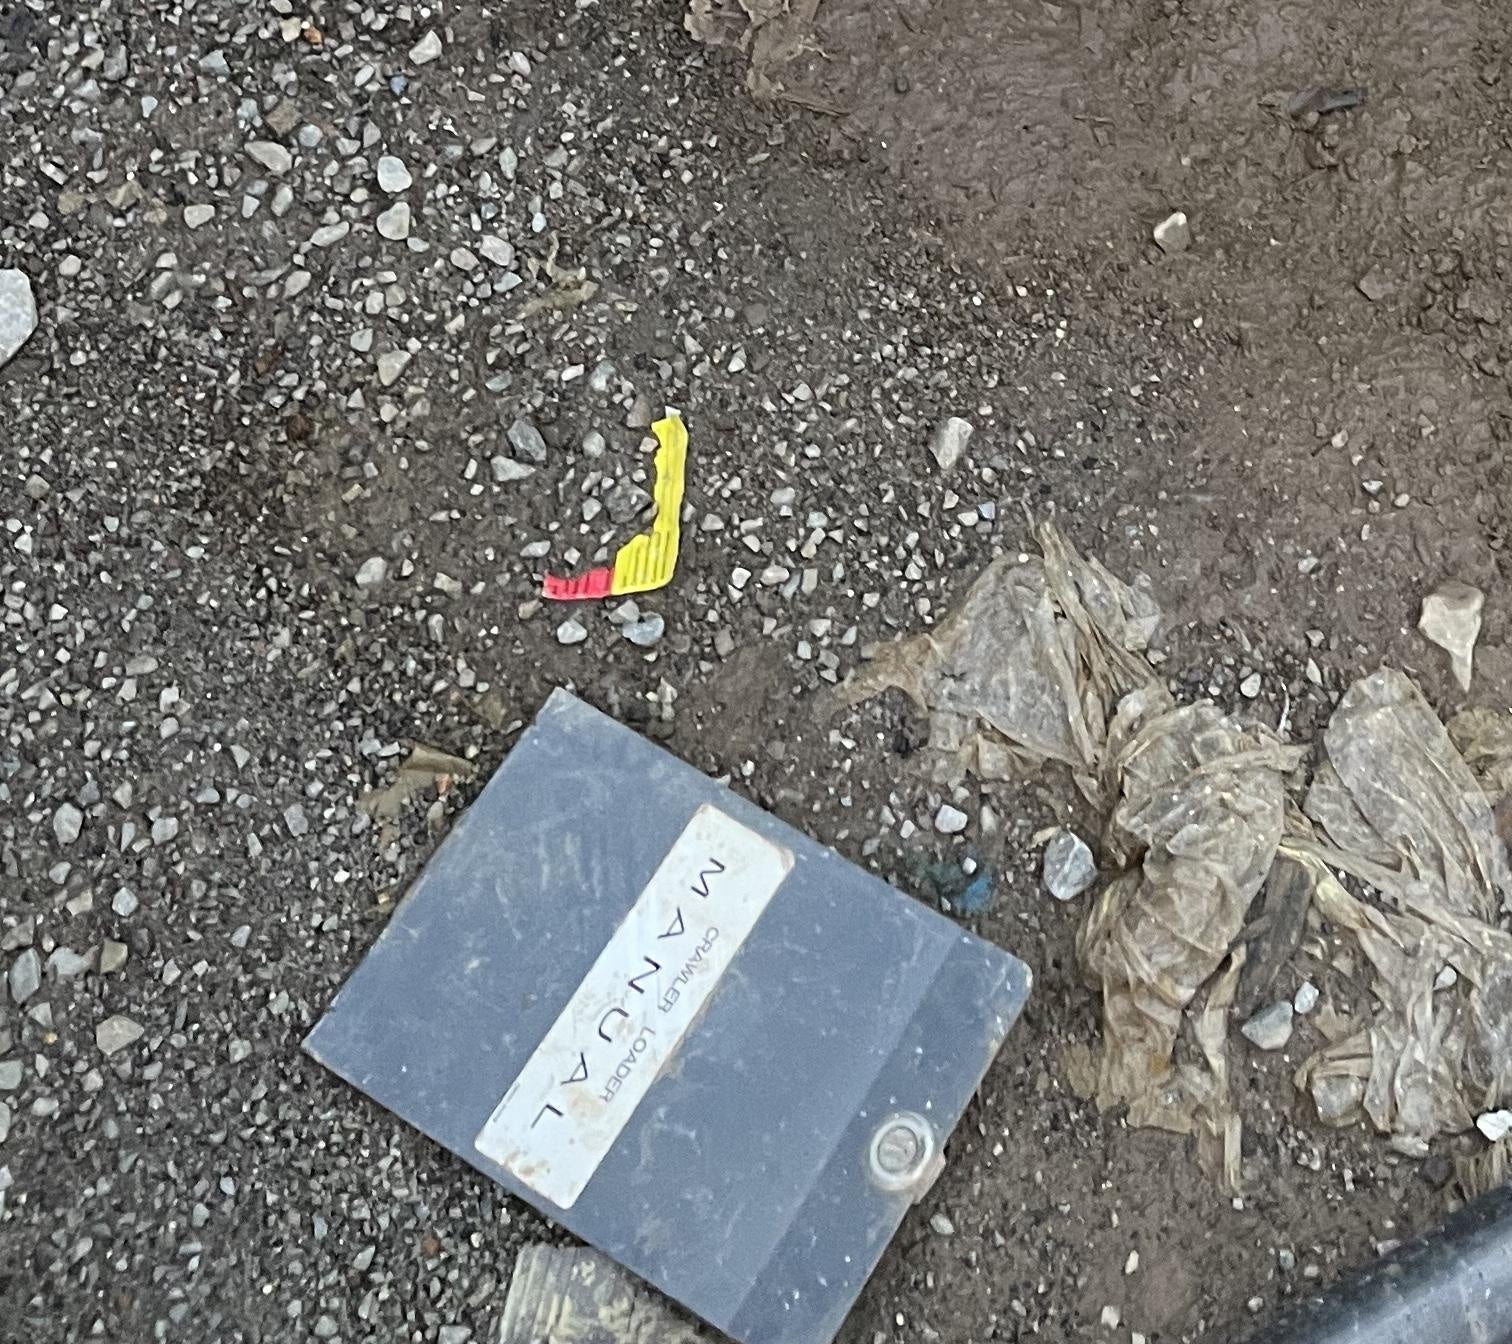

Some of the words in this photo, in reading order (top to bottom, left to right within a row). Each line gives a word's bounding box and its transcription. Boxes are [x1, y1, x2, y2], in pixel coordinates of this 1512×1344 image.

[531, 857, 726, 1129] MANUAL
[657, 926, 720, 1015] CRAWLER
[599, 1025, 657, 1104] LOADER
